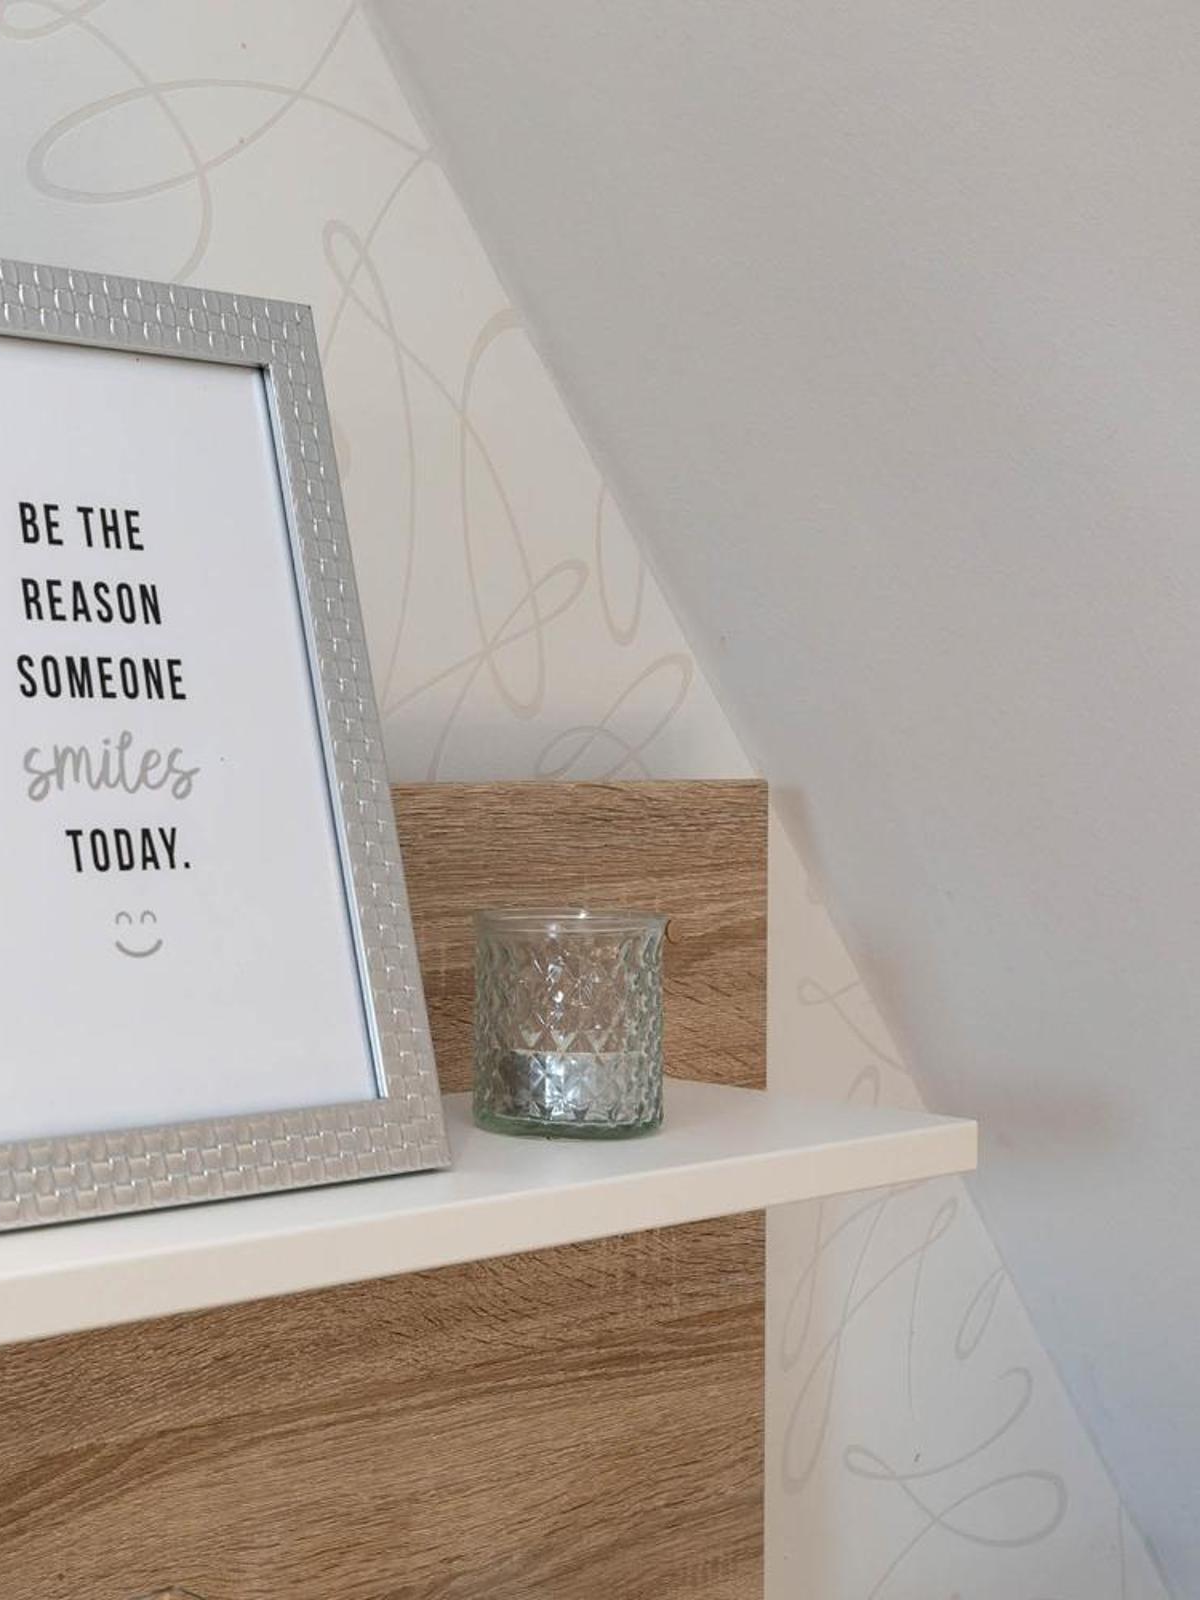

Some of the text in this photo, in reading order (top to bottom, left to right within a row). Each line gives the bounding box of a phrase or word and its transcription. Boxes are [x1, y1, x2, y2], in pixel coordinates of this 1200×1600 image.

[18, 501, 145, 551] BE THE
[21, 577, 162, 625] REASON
[16, 654, 187, 700] SOMEONE
[22, 729, 201, 802] smiles
[65, 827, 191, 873] TODAY.
